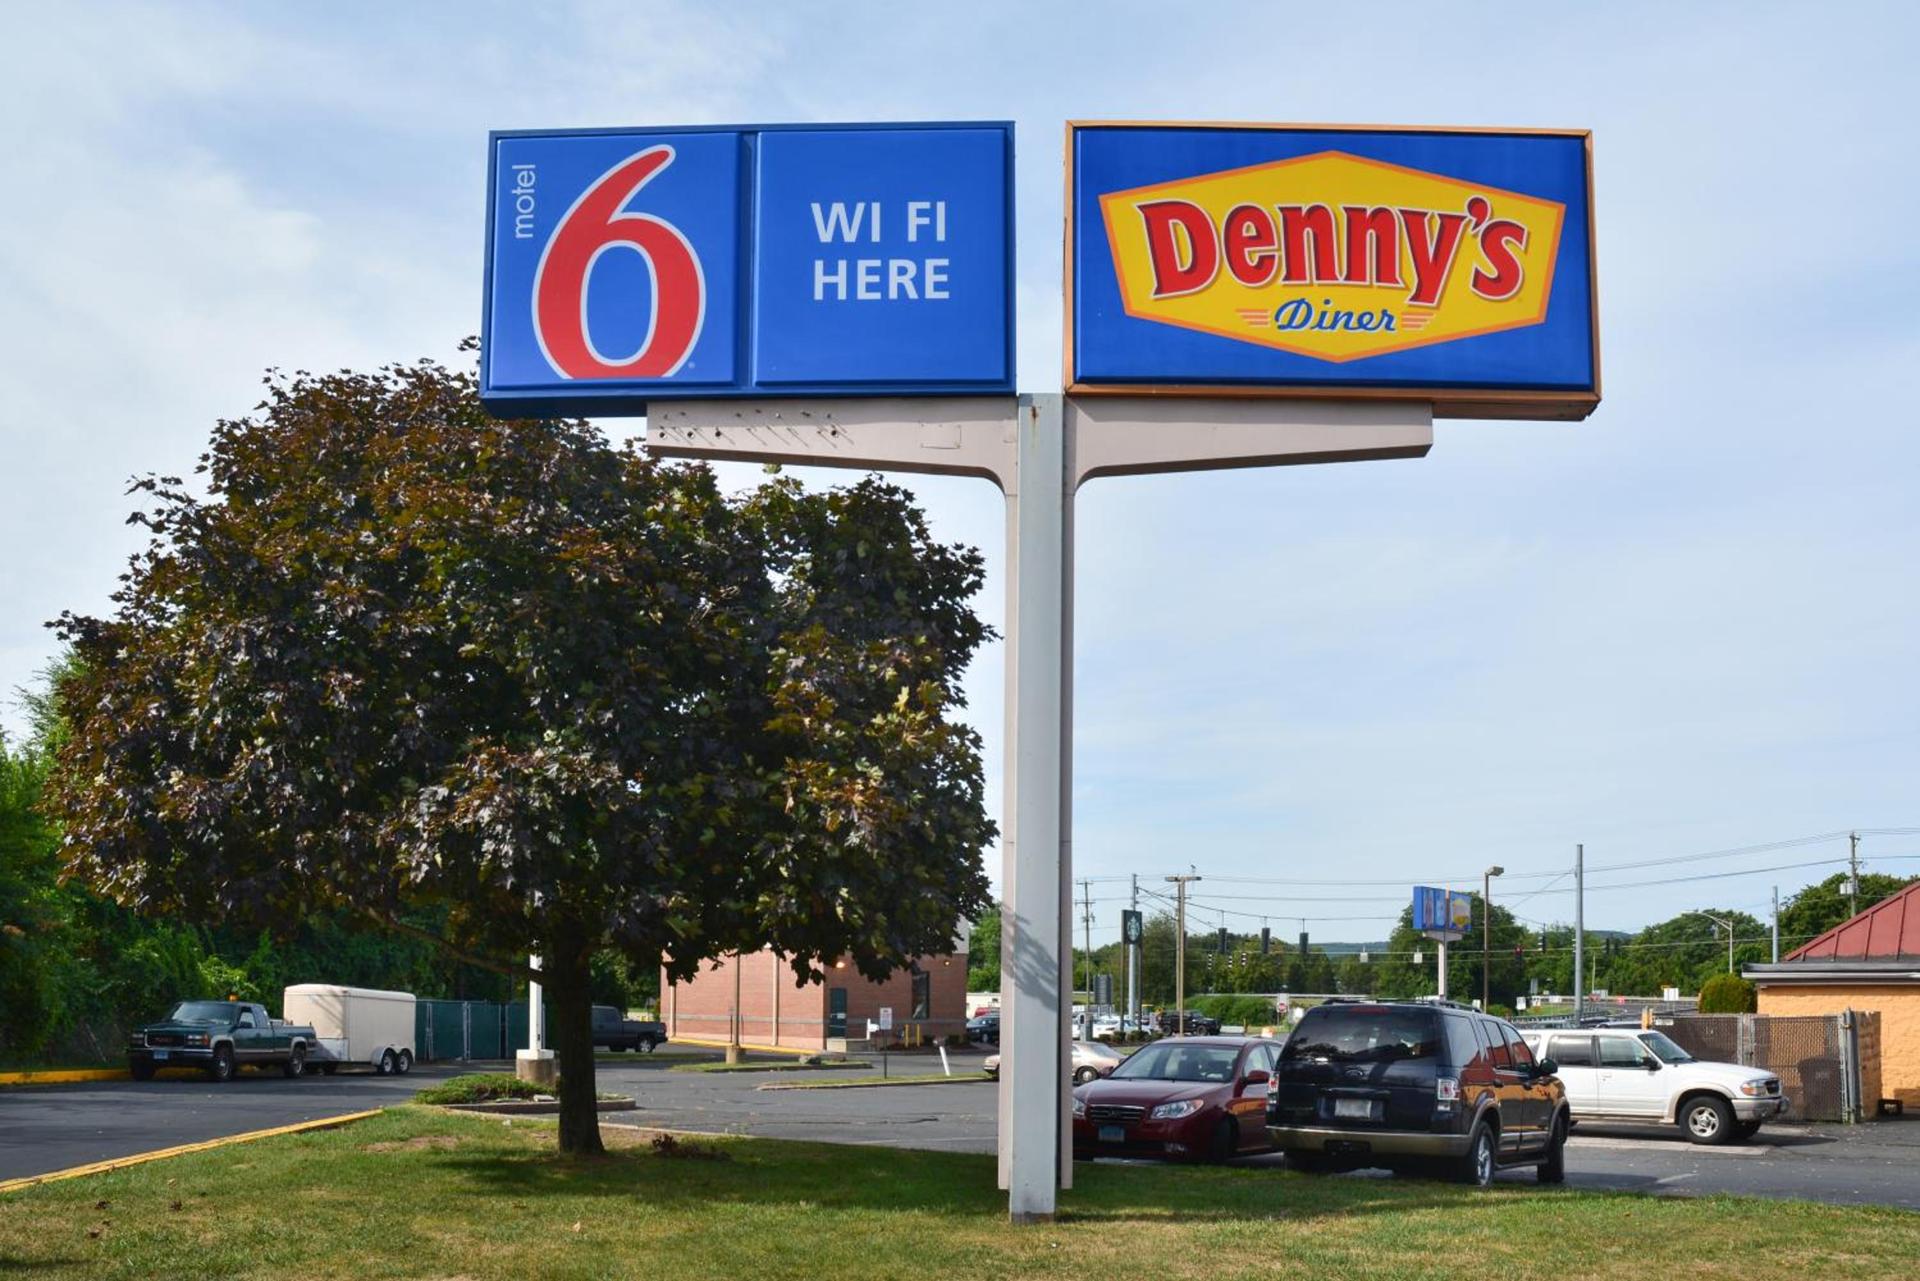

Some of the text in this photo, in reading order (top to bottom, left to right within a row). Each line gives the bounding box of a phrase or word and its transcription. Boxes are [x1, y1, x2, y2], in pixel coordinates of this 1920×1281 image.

[511, 164, 536, 239] motel
[811, 201, 947, 243] WI FI
[531, 144, 707, 379] 6
[813, 257, 951, 301] HERE
[1135, 195, 1530, 308] Denny's
[1274, 297, 1398, 332] Diner
